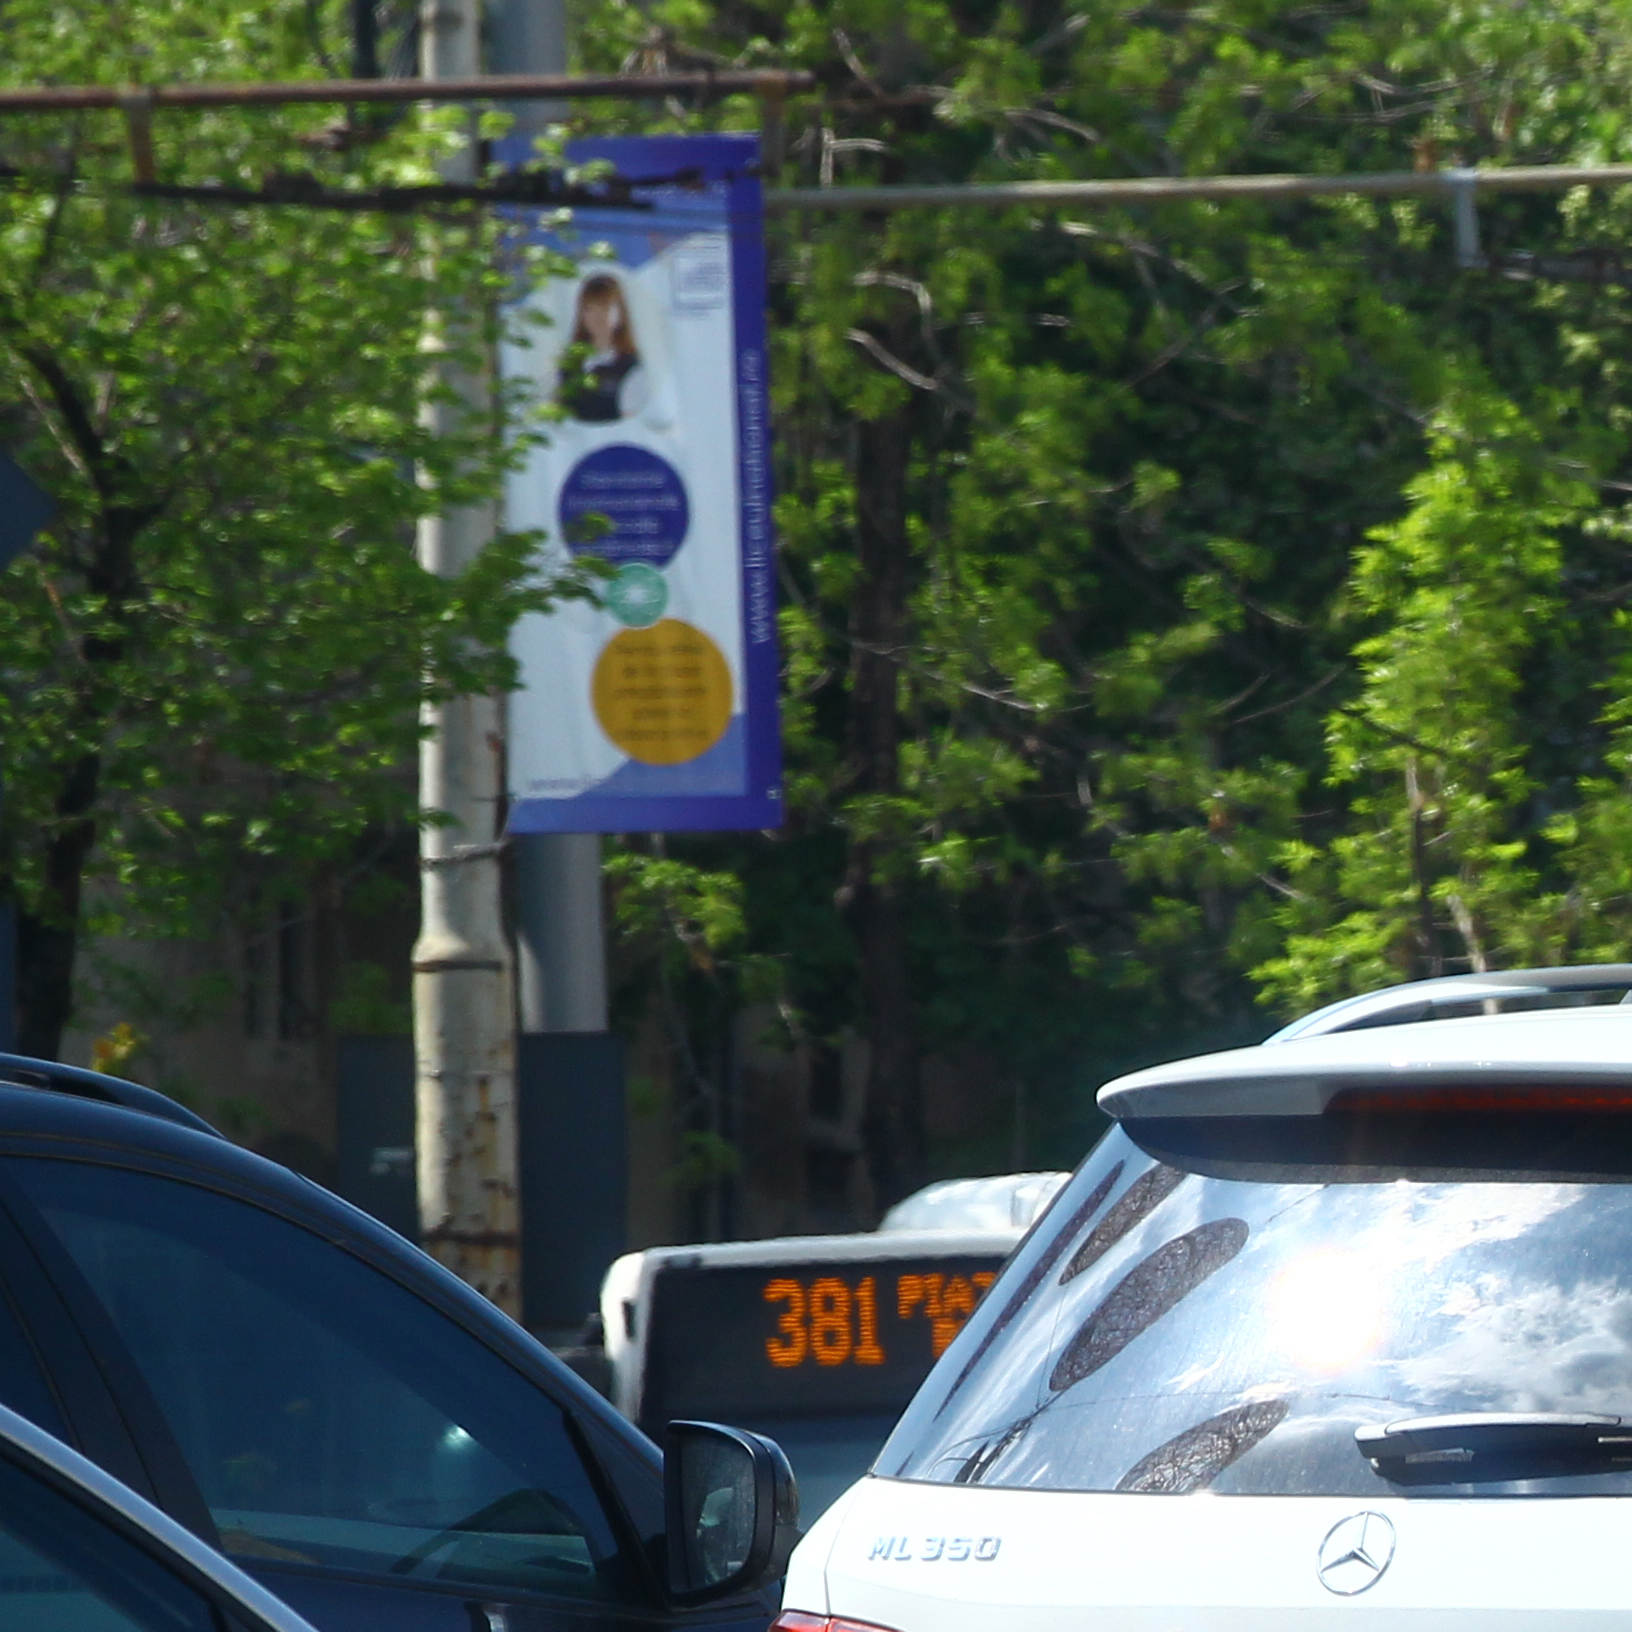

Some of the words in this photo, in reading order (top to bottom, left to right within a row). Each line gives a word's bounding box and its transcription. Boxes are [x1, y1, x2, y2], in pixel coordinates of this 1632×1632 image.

[762, 1275, 886, 1367] 381
[867, 1535, 912, 1562] ML
[919, 1535, 1003, 1562] 350
